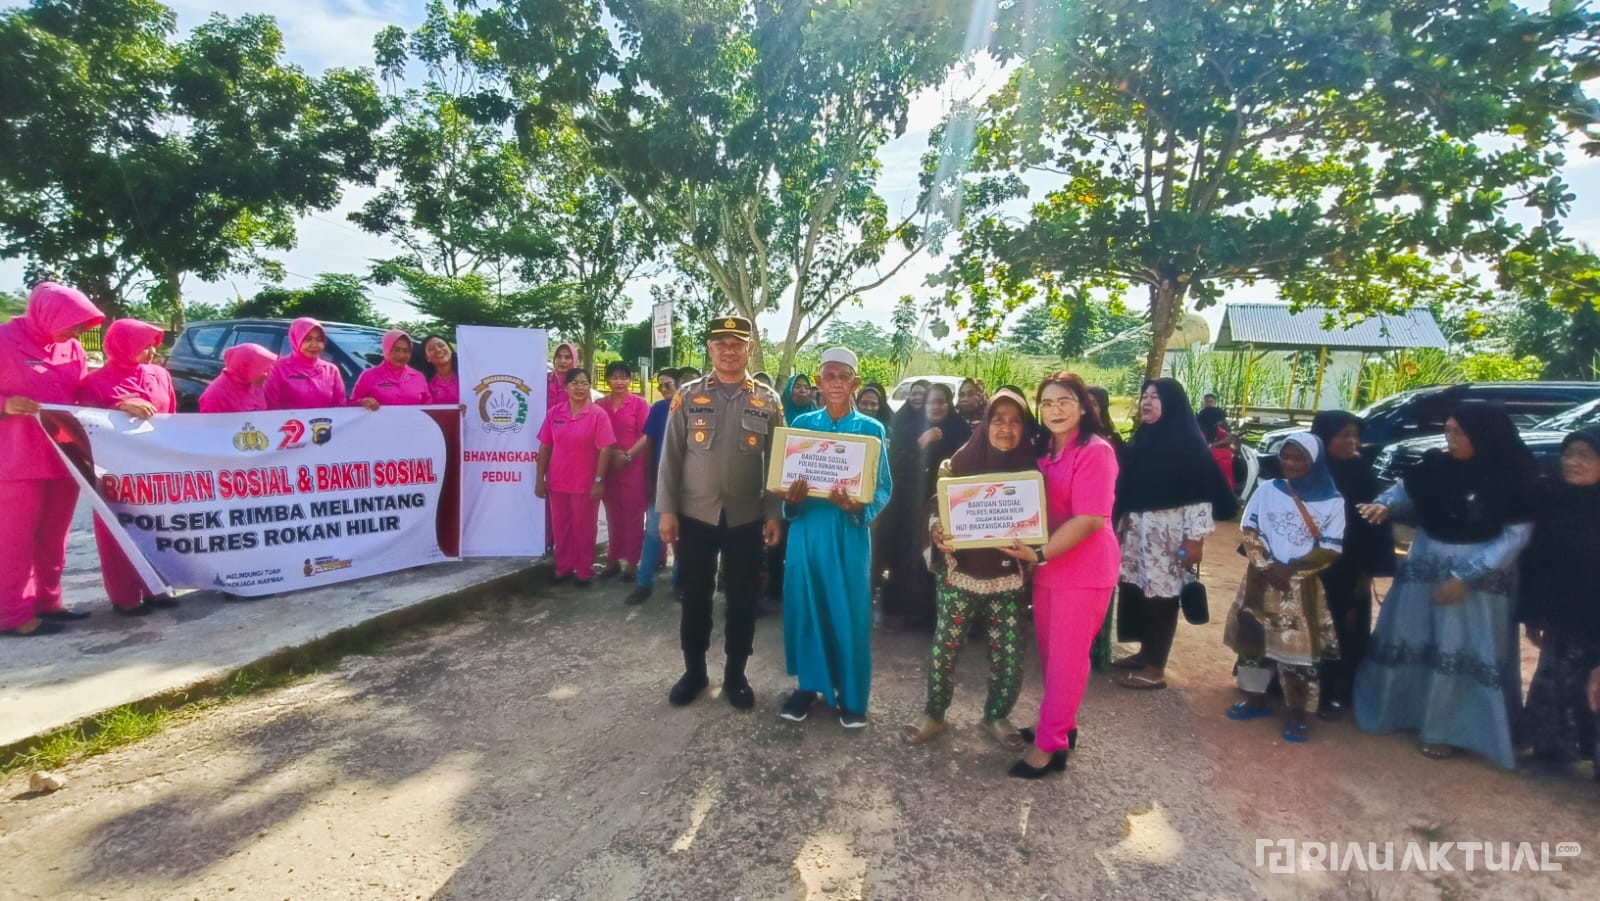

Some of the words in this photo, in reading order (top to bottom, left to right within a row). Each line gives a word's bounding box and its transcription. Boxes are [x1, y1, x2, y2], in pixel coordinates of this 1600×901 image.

[463, 451, 538, 463] BHAYANGKAR
[801, 452, 827, 462] BANTUAN
[828, 456, 848, 465] SOSIAL
[798, 460, 818, 468] POLRES
[818, 462, 836, 470] ROKAN
[101, 470, 215, 505] BANTUAN
[217, 465, 294, 501] SOSIAL
[297, 465, 315, 494] &
[316, 461, 371, 493] BAKTI
[373, 457, 437, 489] SOSIAL
[482, 471, 522, 483] PEDULI
[967, 500, 997, 509] BANTUAN
[998, 498, 1021, 507] SOSIAL
[117, 509, 224, 532] POLSEK
[229, 501, 307, 528] RIMBA
[310, 493, 426, 519] MELINTANG
[966, 508, 988, 516] POLRES
[989, 507, 1009, 515] ROKAN
[955, 523, 968, 532] HUT
[969, 521, 1015, 531] BHAYANGKARA
[155, 531, 259, 555] POLRES
[263, 521, 343, 547] ROKAN
[346, 515, 401, 538] HILIR
